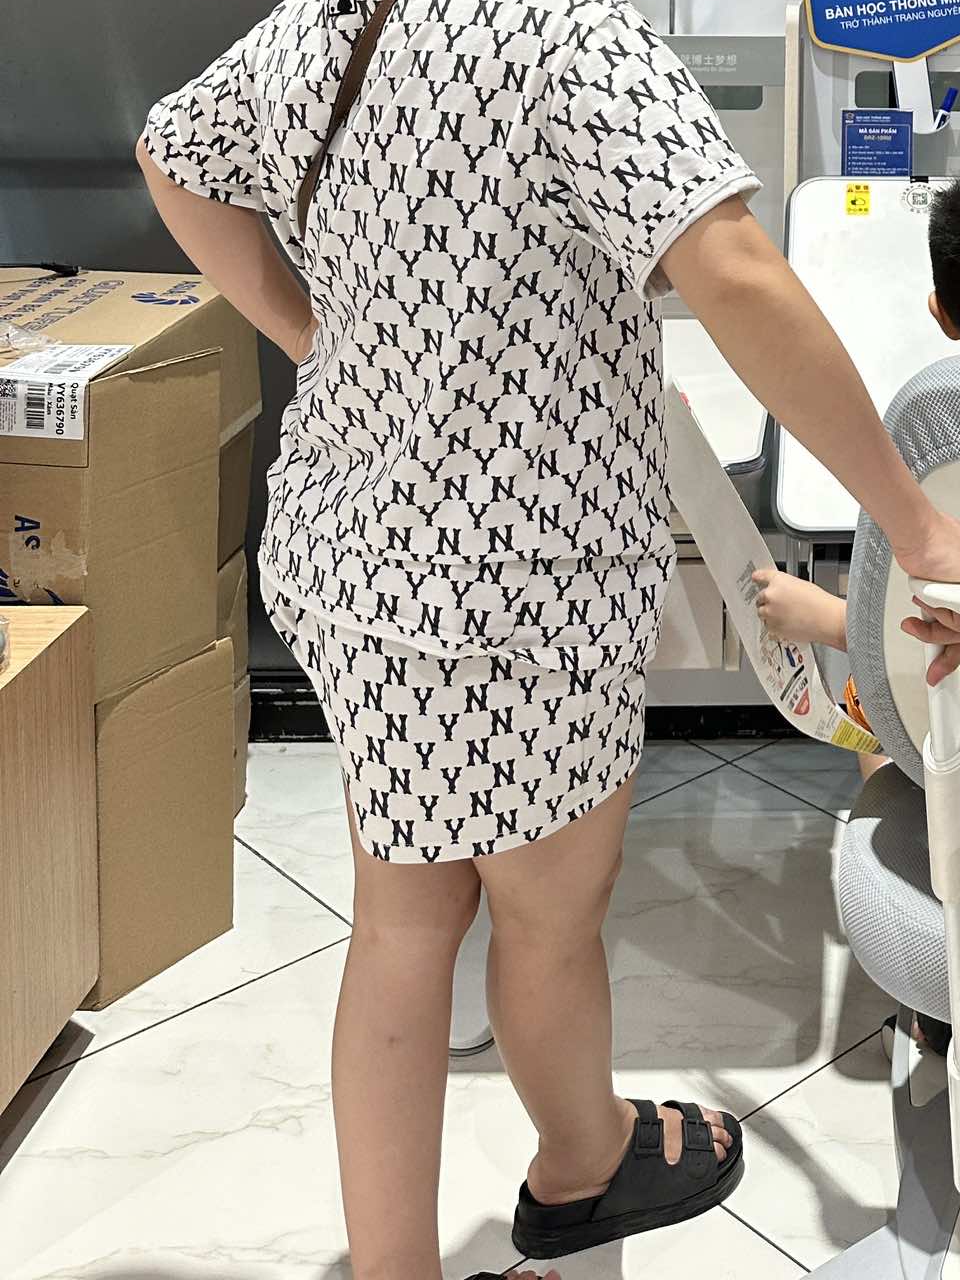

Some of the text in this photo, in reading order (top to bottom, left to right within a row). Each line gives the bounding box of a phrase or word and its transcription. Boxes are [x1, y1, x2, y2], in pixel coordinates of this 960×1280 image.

[825, 5, 853, 20] BÀN
[857, 1, 887, 17] HỌC
[862, 15, 893, 27] THÀNH
[478, 174, 502, 207] N
[422, 223, 450, 254] N
[470, 230, 498, 261] N
[396, 249, 422, 278] Y
[448, 253, 471, 285] Y
[418, 278, 446, 307] N
[464, 285, 492, 315] N
[398, 300, 421, 328] Y
[373, 322, 401, 349] N
[421, 327, 444, 356] N
[457, 334, 486, 366] N
[532, 340, 558, 370] Y
[70, 382, 79, 403] Quạt
[500, 368, 529, 397] N
[55, 382, 66, 435] VY636790
[476, 396, 501, 425] Y
[527, 393, 552, 424] Y
[497, 421, 524, 450] N
[472, 447, 498, 476] Y
[390, 479, 417, 506] N
[442, 473, 469, 502] N
[489, 474, 517, 503] N
[466, 501, 490, 531] Y
[385, 526, 413, 553] N
[434, 526, 462, 556] N
[487, 523, 515, 554] N
[383, 655, 408, 687] N
[436, 658, 460, 688] Y
[488, 654, 513, 683] N
[362, 679, 384, 713] N
[411, 686, 435, 717] Y
[463, 682, 490, 714] N
[518, 675, 540, 705] Y
[489, 705, 514, 737] N
[542, 696, 564, 726] Y
[384, 712, 409, 743] N
[437, 713, 460, 742] Y
[518, 727, 540, 757] Y
[365, 734, 387, 767] N
[413, 742, 436, 771] Y
[465, 736, 491, 767] N
[542, 745, 563, 776] Y
[388, 766, 413, 795] N
[440, 766, 463, 795] Y
[491, 758, 516, 789] N
[369, 787, 390, 820] N
[469, 788, 494, 818] N
[521, 777, 542, 807] Y
[417, 795, 440, 822] Y
[390, 819, 415, 848] N
